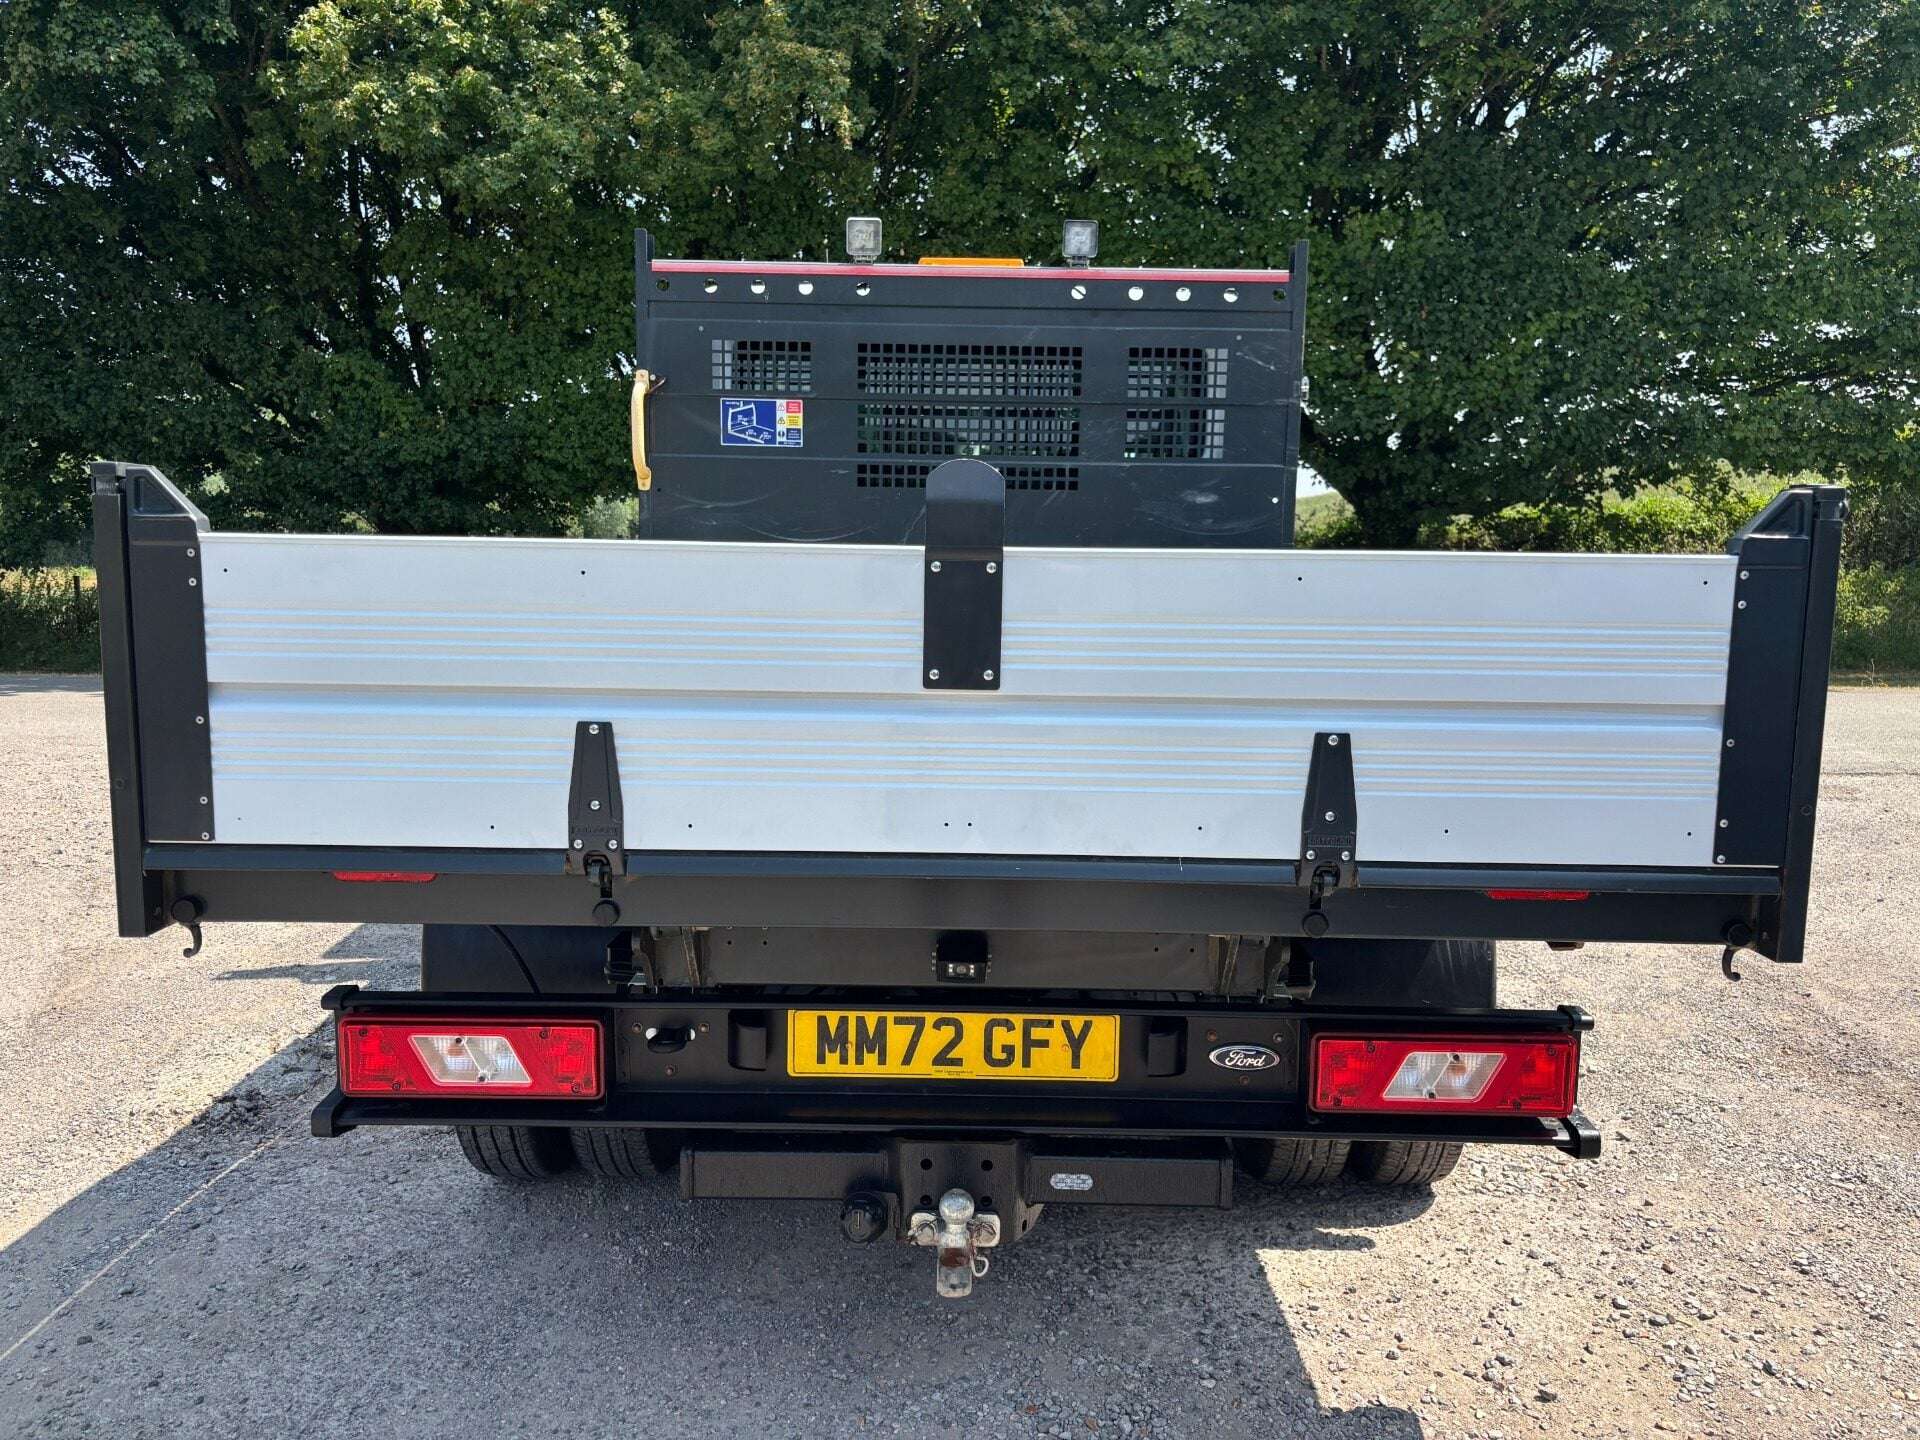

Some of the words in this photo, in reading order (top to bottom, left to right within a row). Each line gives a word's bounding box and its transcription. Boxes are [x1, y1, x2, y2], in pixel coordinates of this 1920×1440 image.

[816, 1015, 964, 1067] MM72
[983, 1018, 1093, 1069] GFY
[1225, 1049, 1266, 1067] Ford
